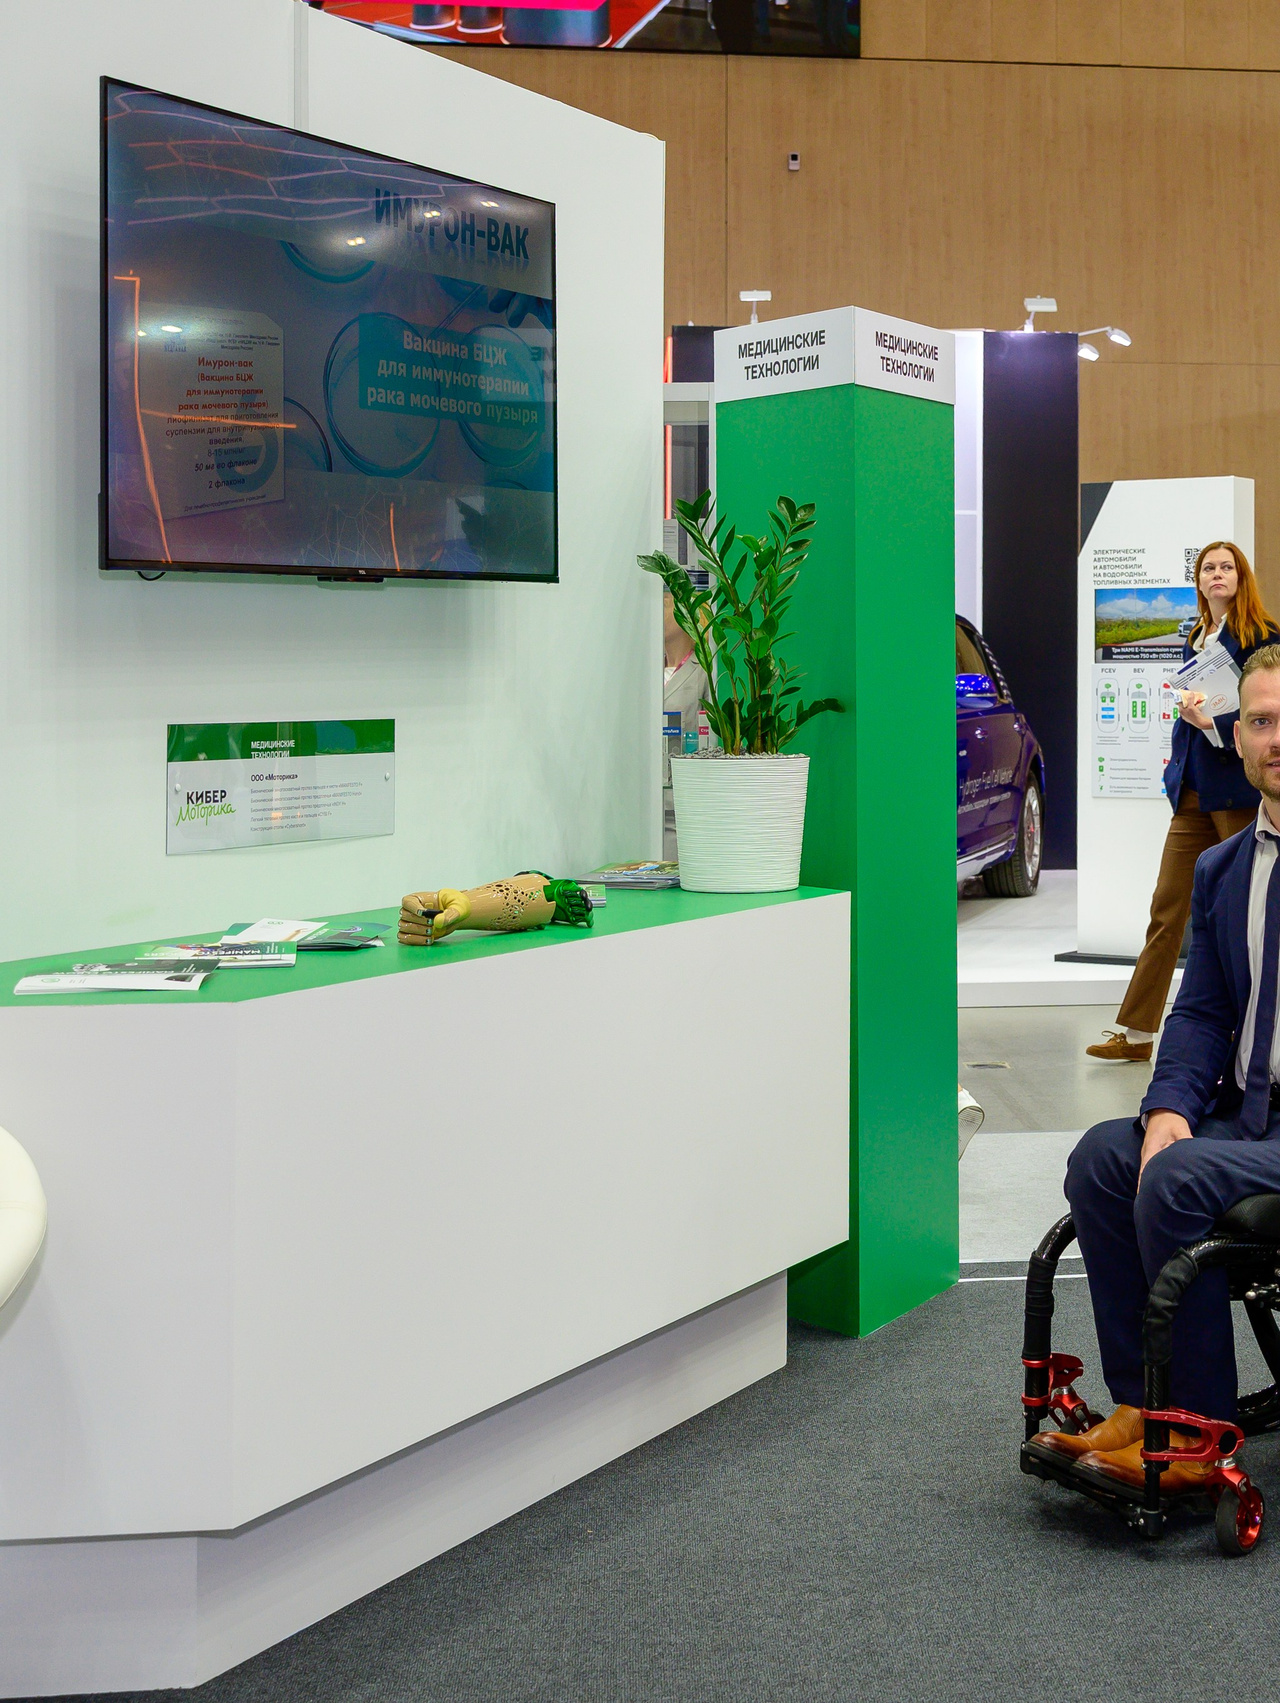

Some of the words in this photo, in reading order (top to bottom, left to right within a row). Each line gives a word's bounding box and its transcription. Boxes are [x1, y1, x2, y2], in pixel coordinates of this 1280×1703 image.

[375, 188, 529, 260] ИМУРОН-ВАК
[403, 330, 468, 359] Вакцина
[474, 343, 507, 366] БЦЖ
[738, 329, 826, 360] МЕДИЦИНСКИЕ
[875, 331, 939, 361] МЕДИЦИНСКИЕ
[198, 356, 253, 369] Имурон-вак
[744, 354, 820, 381] ТЕХНОЛОГИИ
[880, 355, 935, 383] ТЕХНОЛОГИИ
[236, 373, 253, 382] БЦЖ
[378, 359, 407, 378] для
[412, 363, 529, 396] иммунотерапии
[186, 388, 201, 397] для
[178, 403, 199, 412] рака
[367, 387, 404, 406] рака
[410, 393, 482, 417] мочевого
[486, 403, 538, 426] пузыря
[250, 739, 295, 749] МЕДИЦИНСКИЕ
[251, 750, 290, 759] ТЕХНОЛОГИИ
[250, 774, 264, 782] ООО
[265, 773, 298, 782] «Моторика»
[186, 789, 227, 805] КИБЕР
[176, 802, 236, 826] Моторика
